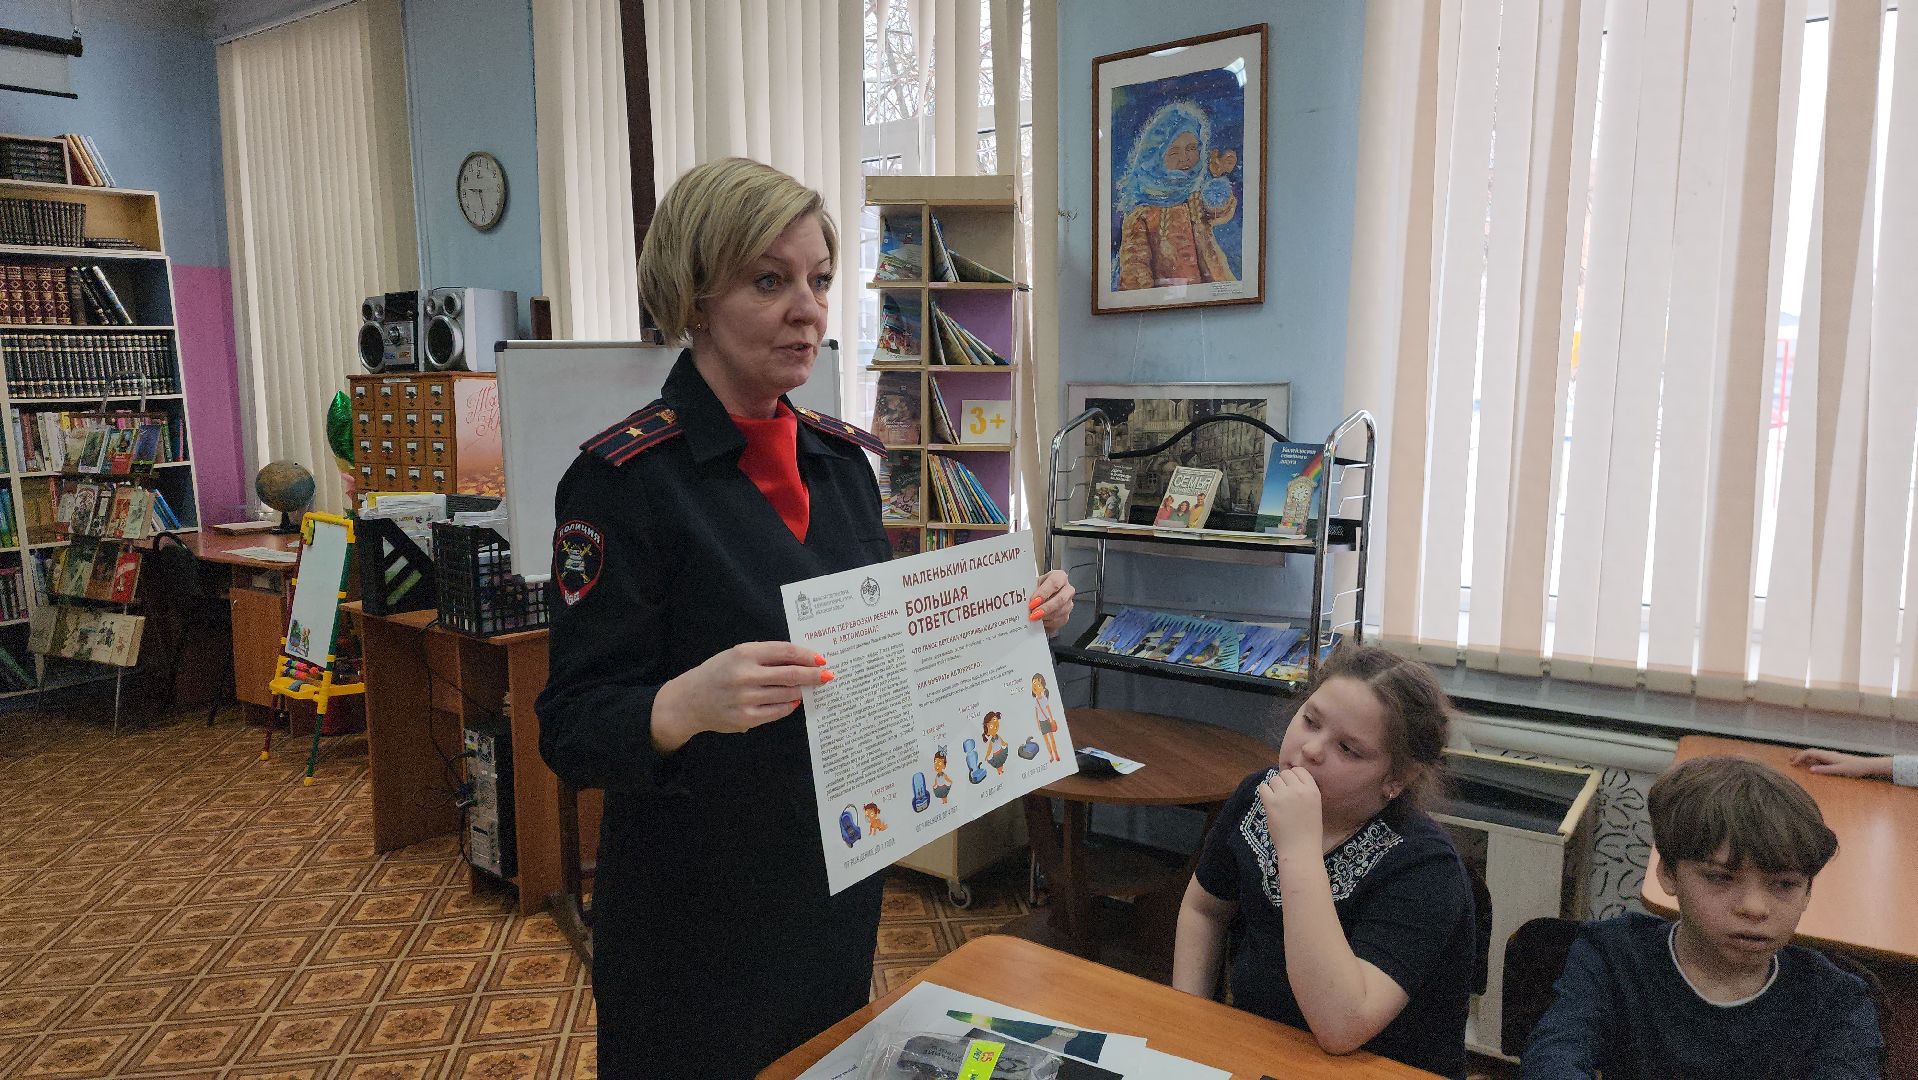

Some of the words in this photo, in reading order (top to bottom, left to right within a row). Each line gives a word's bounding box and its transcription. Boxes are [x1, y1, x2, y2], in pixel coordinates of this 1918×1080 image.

[970, 406, 1007, 435] 3+
[1174, 474, 1213, 490] СЕМЬЯ
[559, 523, 601, 544] ПОЛИЦИЯ
[902, 559, 968, 588] МАЛЕНЬКИЙ
[969, 548, 1021, 570] ПАССАЖИР
[905, 586, 968, 617] БОЛЬШАЯ
[908, 589, 1027, 636] ОТВЕТСТВЕННОСТЬ!
[804, 626, 837, 641] ПРАВИЛА
[911, 646, 921, 655] ЧТО
